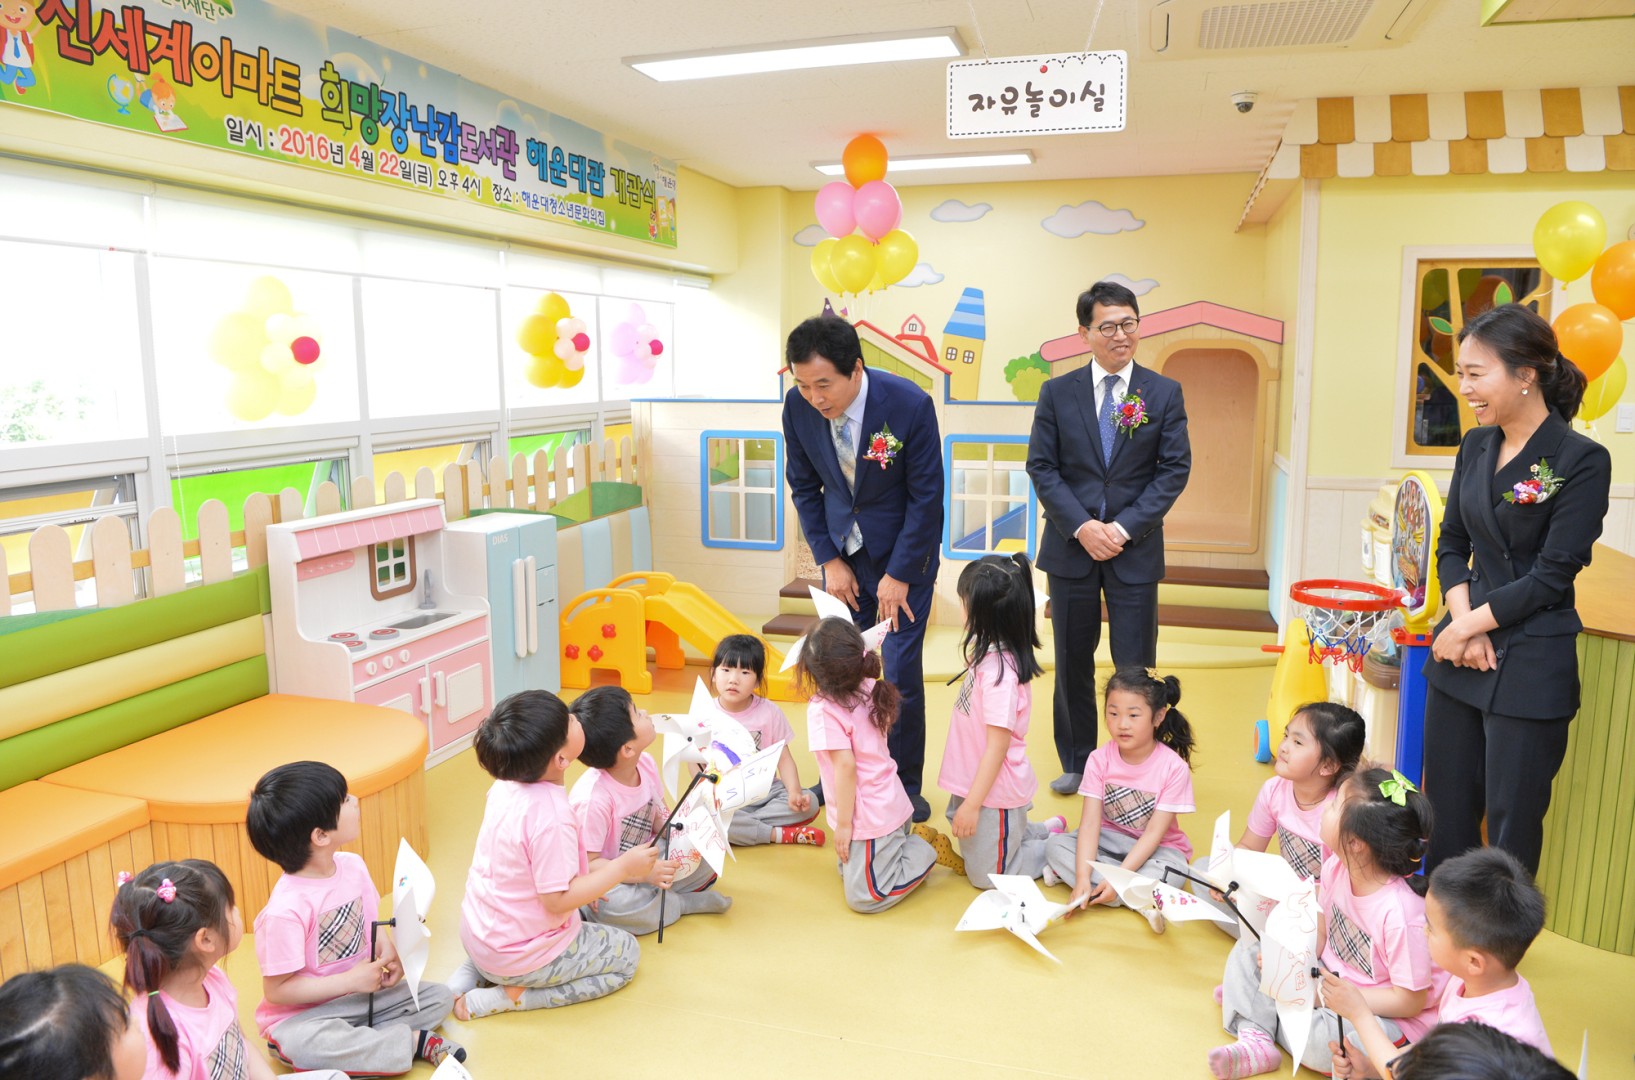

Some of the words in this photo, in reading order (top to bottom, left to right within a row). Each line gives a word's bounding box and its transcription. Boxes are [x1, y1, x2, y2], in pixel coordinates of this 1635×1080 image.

[36, 0, 303, 117] 신세계이마트
[320, 60, 520, 182] 희망장난감도서관
[526, 137, 605, 198] 해운대관
[610, 167, 657, 214] 개관식
[968, 80, 1105, 118] 자유놀이실
[279, 127, 344, 165] 2016년
[349, 144, 374, 172] 4월
[379, 151, 433, 188] 22일(금)
[437, 169, 459, 190] 오후
[462, 177, 481, 196] 4시
[521, 190, 605, 226] 해운대청소년문화의집
[492, 533, 509, 545] DIAS
